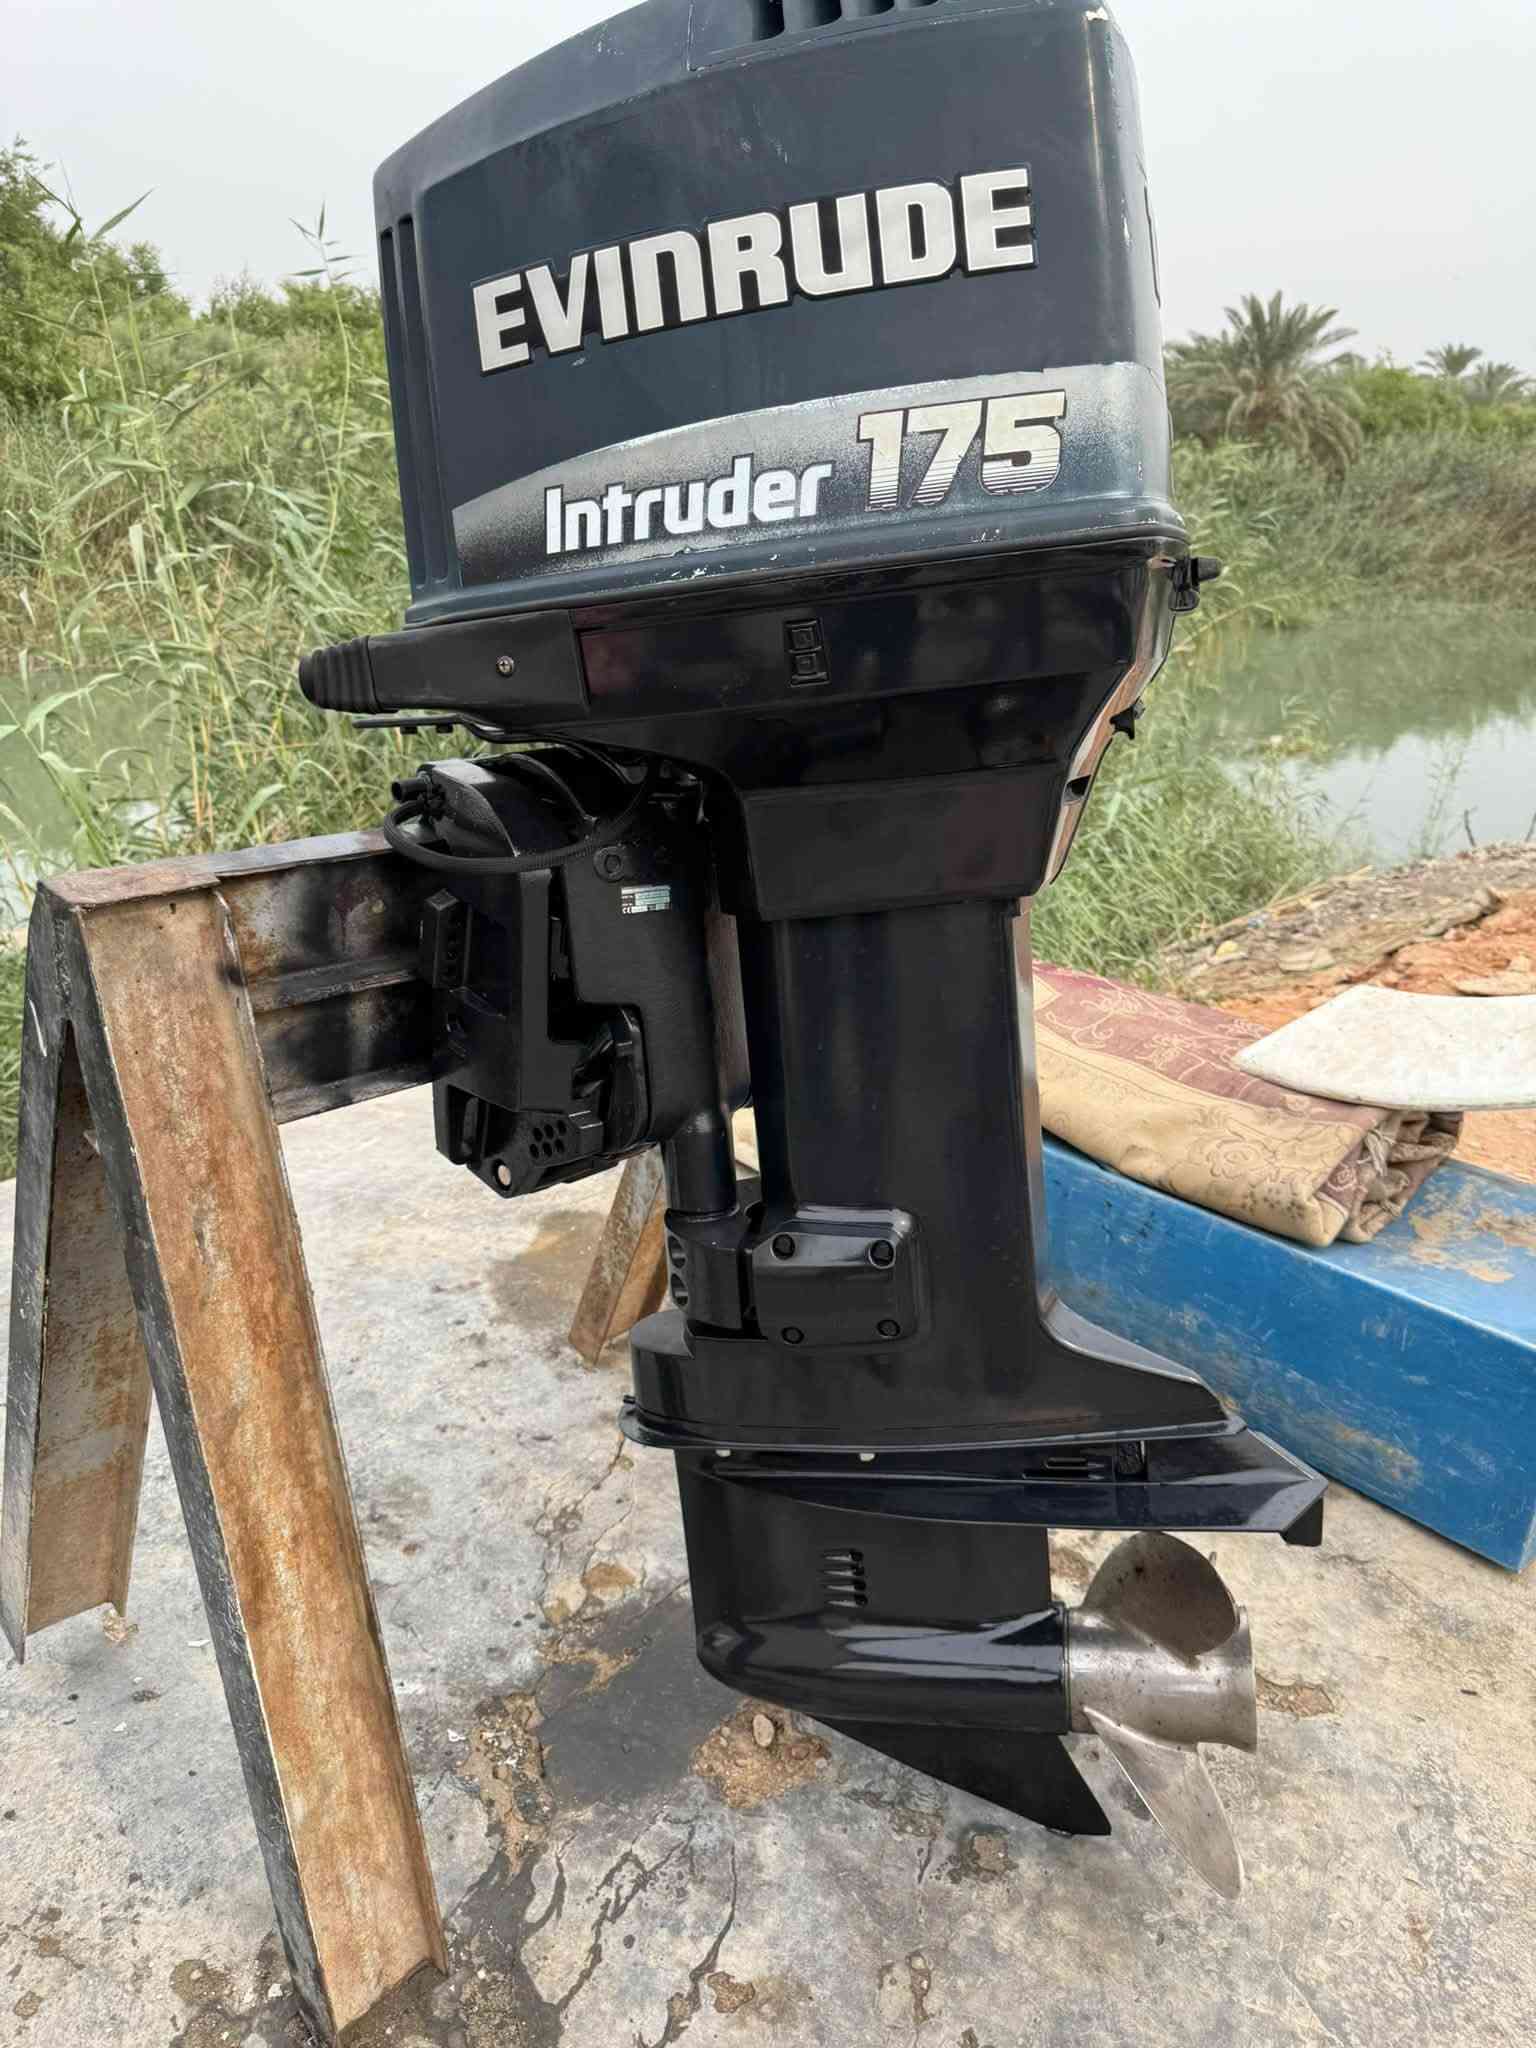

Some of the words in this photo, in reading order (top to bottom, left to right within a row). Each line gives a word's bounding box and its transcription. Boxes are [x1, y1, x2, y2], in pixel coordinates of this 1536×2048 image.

[473, 168, 1036, 374] EVINRUDE
[544, 456, 833, 555] Intruder
[858, 390, 1067, 512] 175
